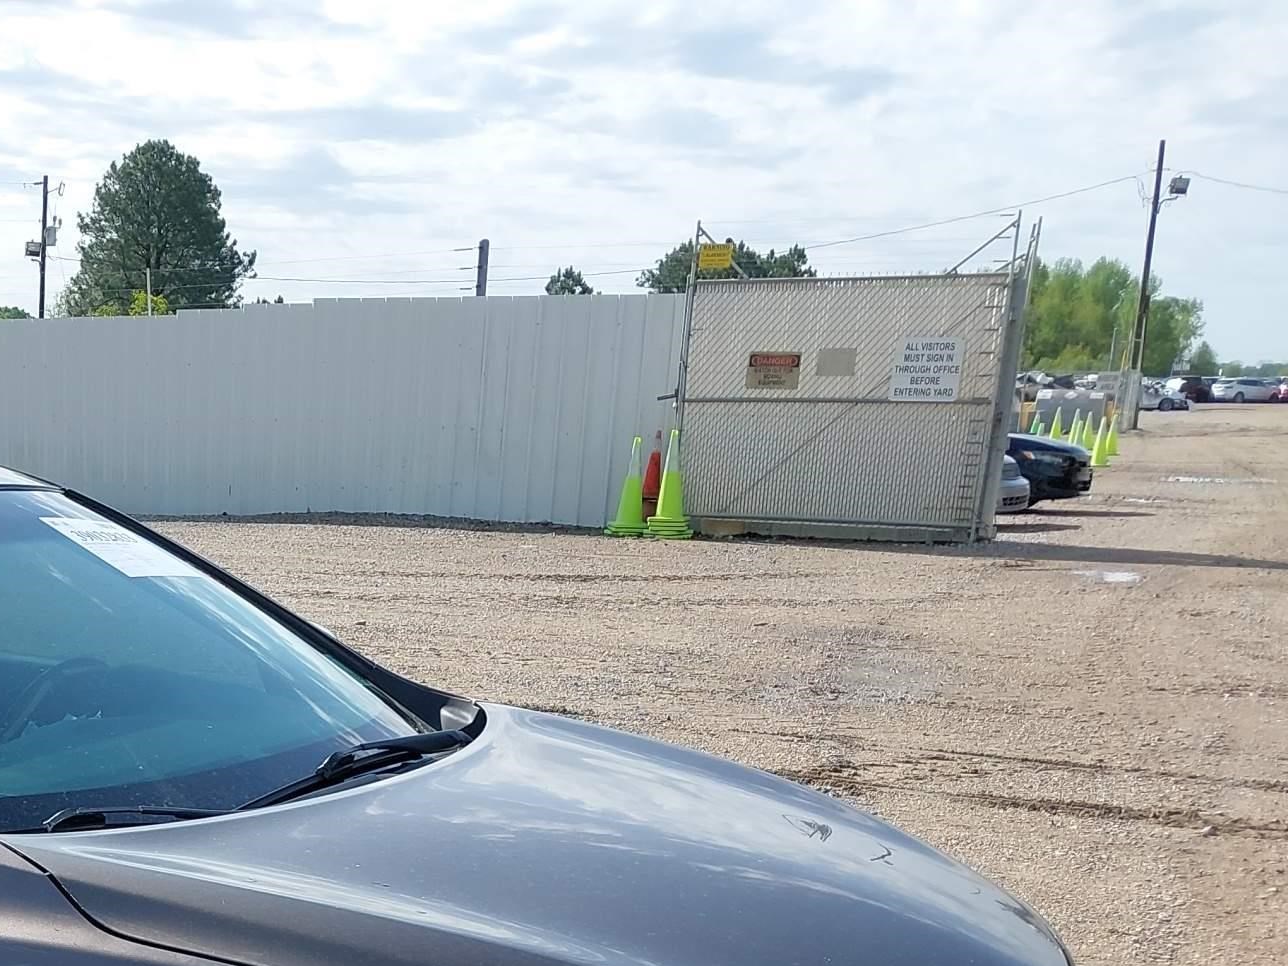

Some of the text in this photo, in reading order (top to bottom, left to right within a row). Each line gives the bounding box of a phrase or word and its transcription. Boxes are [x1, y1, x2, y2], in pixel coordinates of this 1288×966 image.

[905, 342, 956, 351] ALL VISITORS
[757, 356, 793, 365] DANGER
[904, 353, 954, 363] MUST SIGN IN
[895, 365, 960, 374] THROUGH OFFICE
[910, 376, 941, 385] BEFORE
[894, 387, 954, 397] ENTERING YARD
